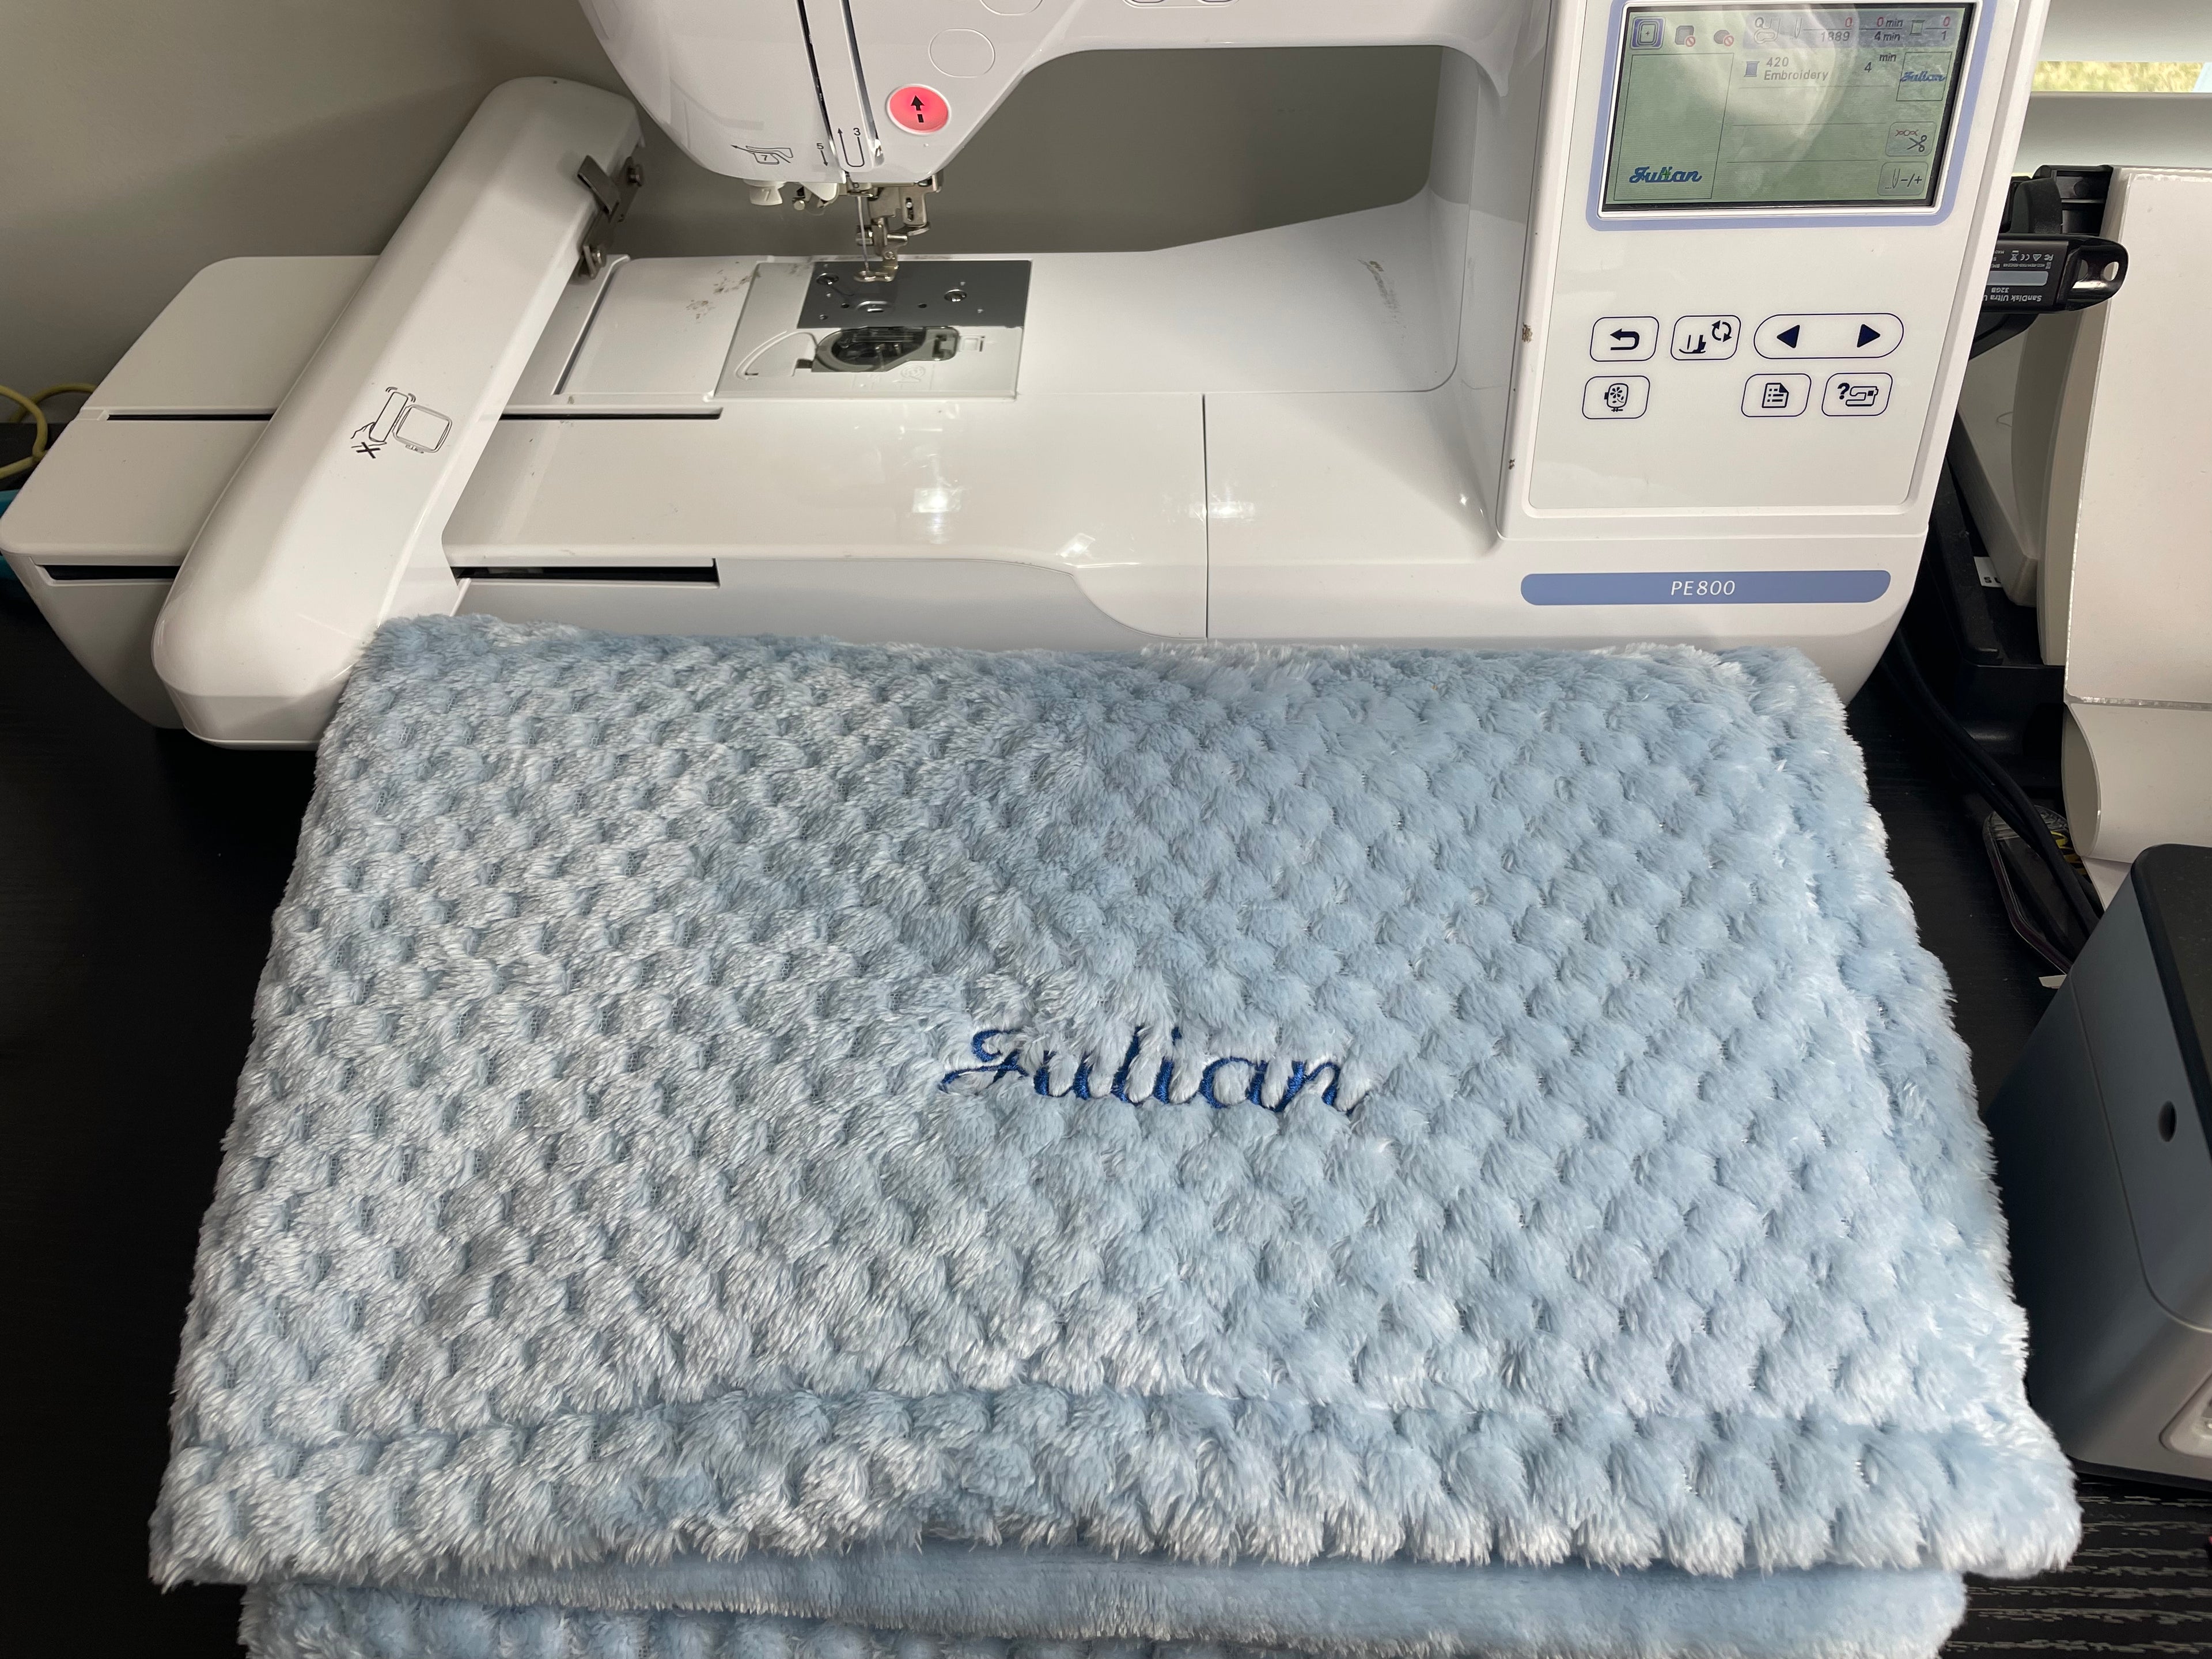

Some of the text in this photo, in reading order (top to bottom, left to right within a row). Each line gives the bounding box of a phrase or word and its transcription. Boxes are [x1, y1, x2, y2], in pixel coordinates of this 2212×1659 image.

[1844, 17, 1853, 28] 0
[1877, 16, 1903, 27] 0 min
[1943, 16, 1951, 27] 0
[1874, 31, 1901, 41] 4 min
[1941, 30, 1947, 41] 1
[1766, 56, 1789, 67] 420
[1879, 52, 1897, 62] min
[1864, 61, 1873, 73] 4
[1764, 70, 1830, 81] Embroidery
[853, 127, 861, 137] 3
[1629, 165, 1703, 183] Julian
[1671, 580, 1736, 596] PE800
[938, 1026, 1371, 1116] Julian
